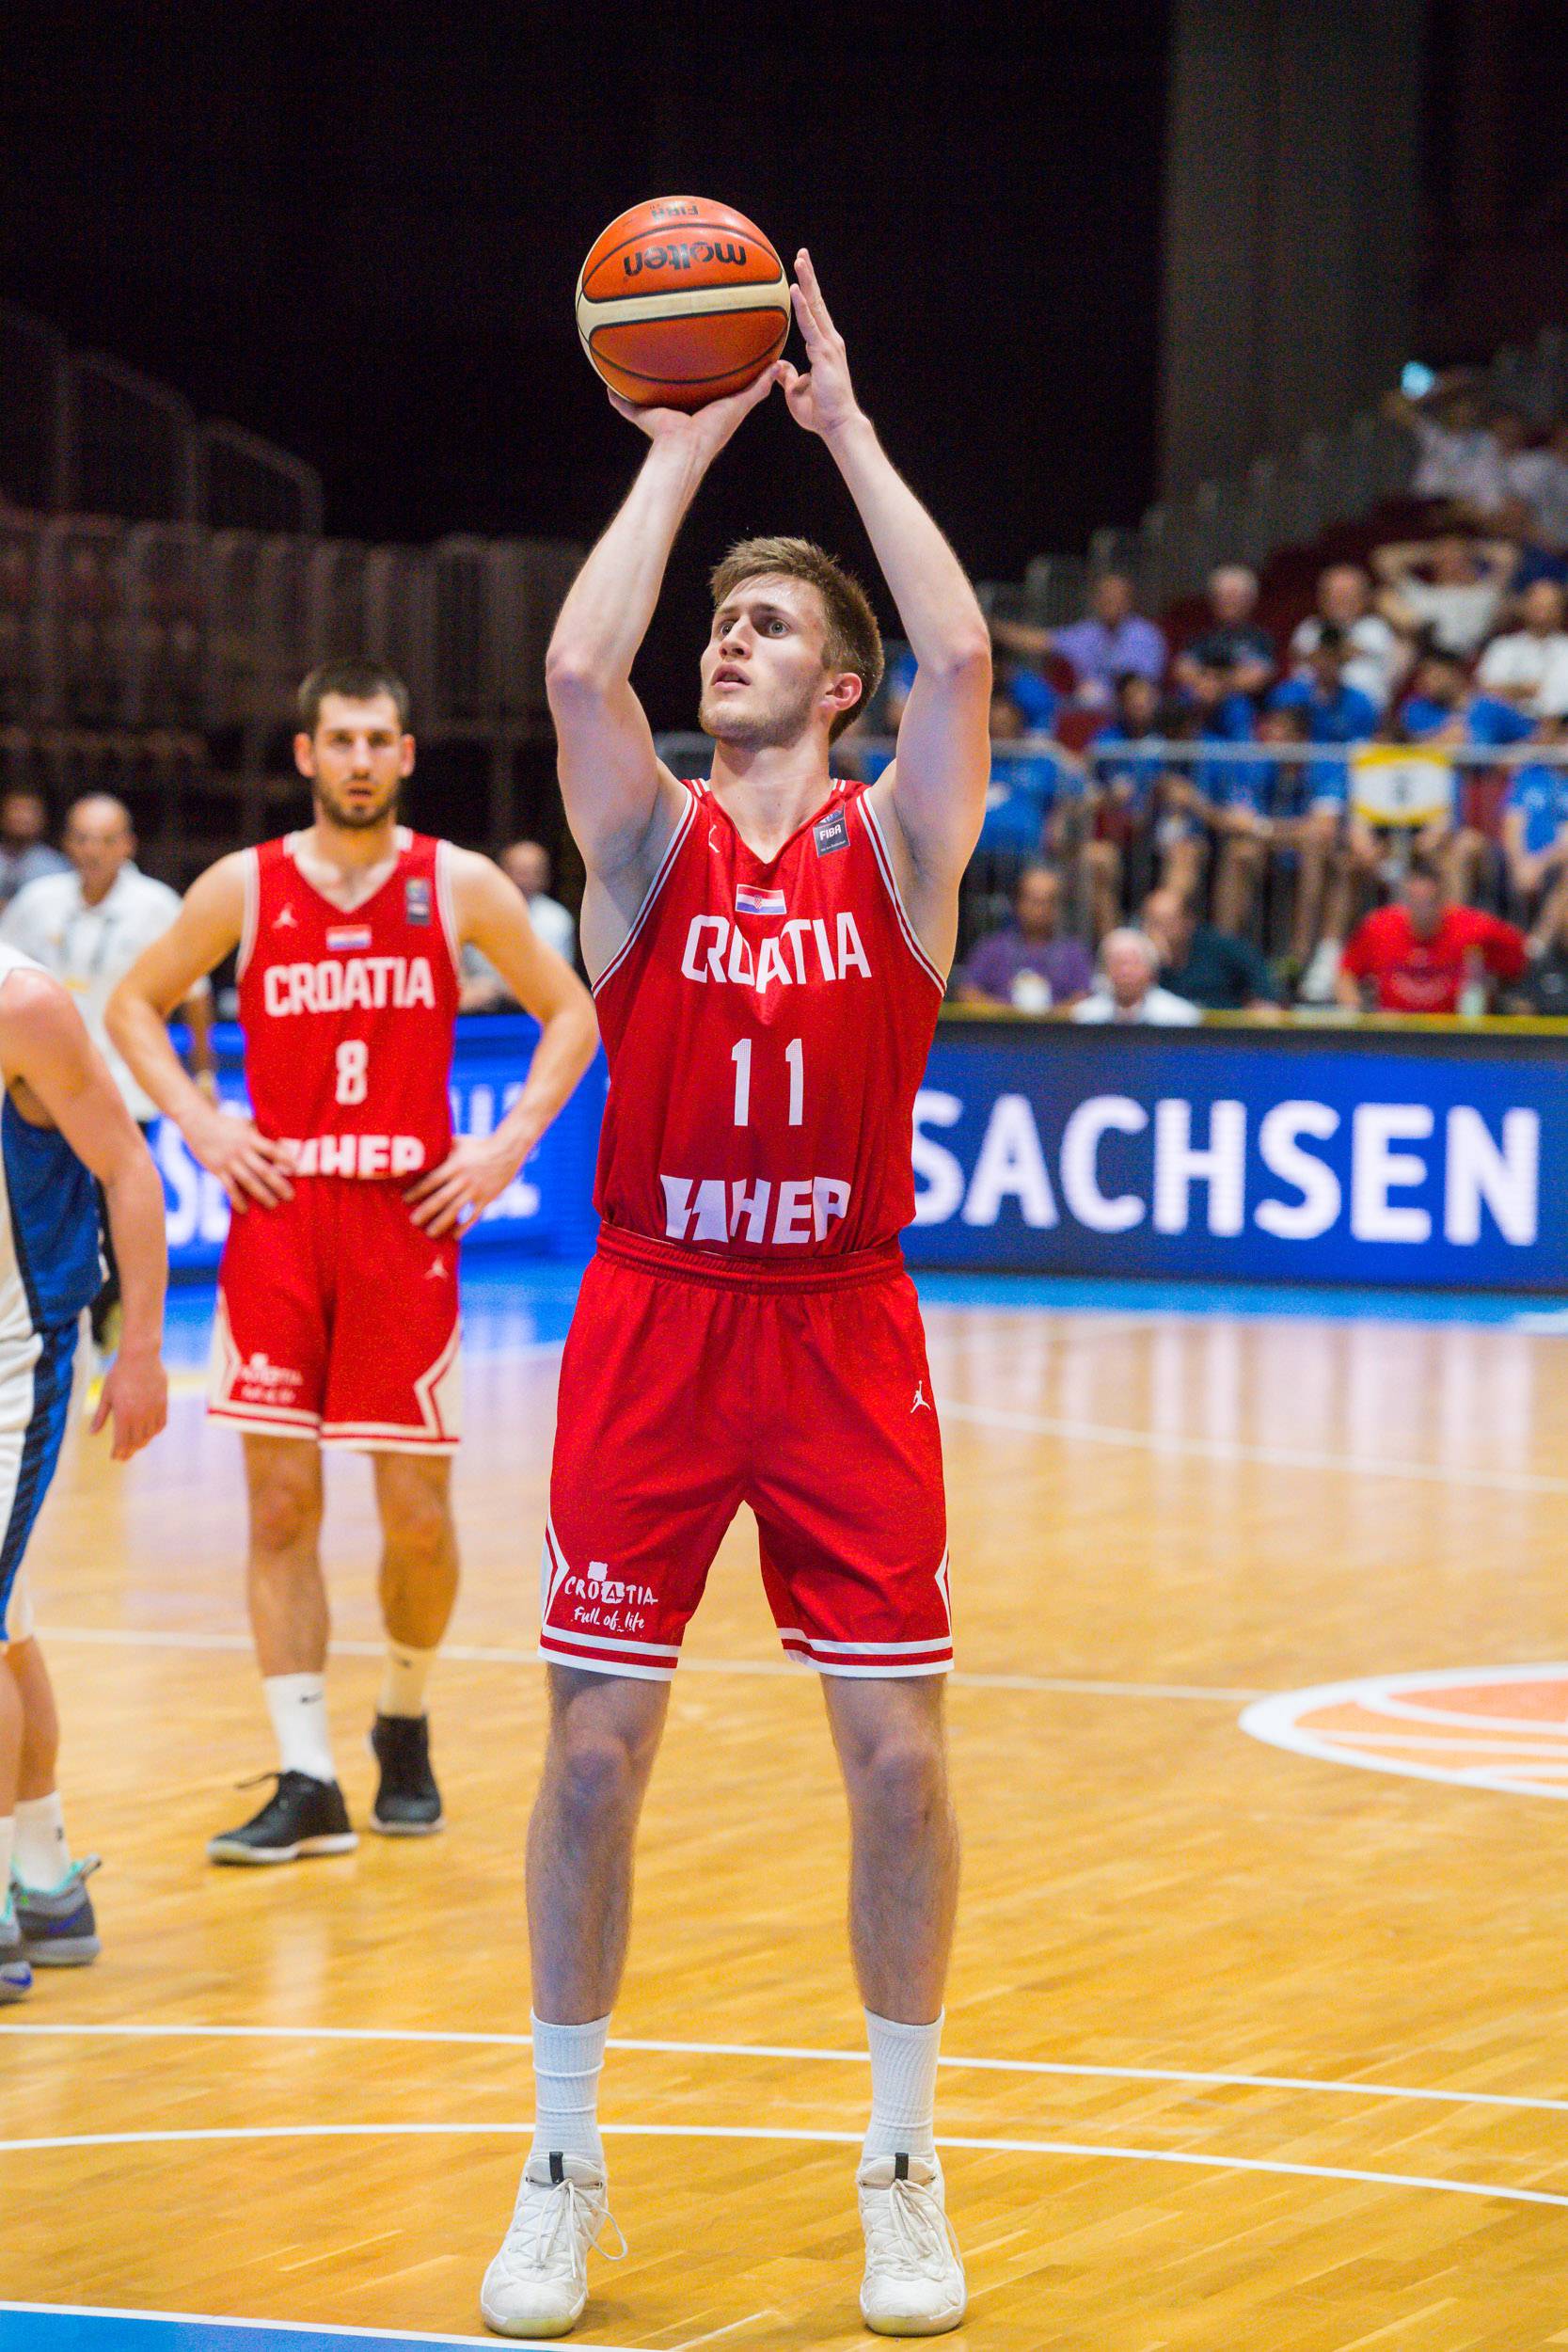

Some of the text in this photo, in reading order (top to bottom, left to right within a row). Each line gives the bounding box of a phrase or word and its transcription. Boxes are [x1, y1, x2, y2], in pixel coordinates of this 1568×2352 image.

[624, 241, 747, 278] molten
[819, 824, 842, 840] FIBA
[681, 912, 872, 993] CROATIA
[263, 956, 435, 1017] CROATIA
[335, 1039, 368, 1105] 8
[731, 1038, 803, 1126] 11
[911, 1089, 1541, 1247] SACHSEN
[564, 1576, 658, 1606] CROATIA
[603, 1610, 619, 1630] of
[625, 1612, 645, 1632] life
